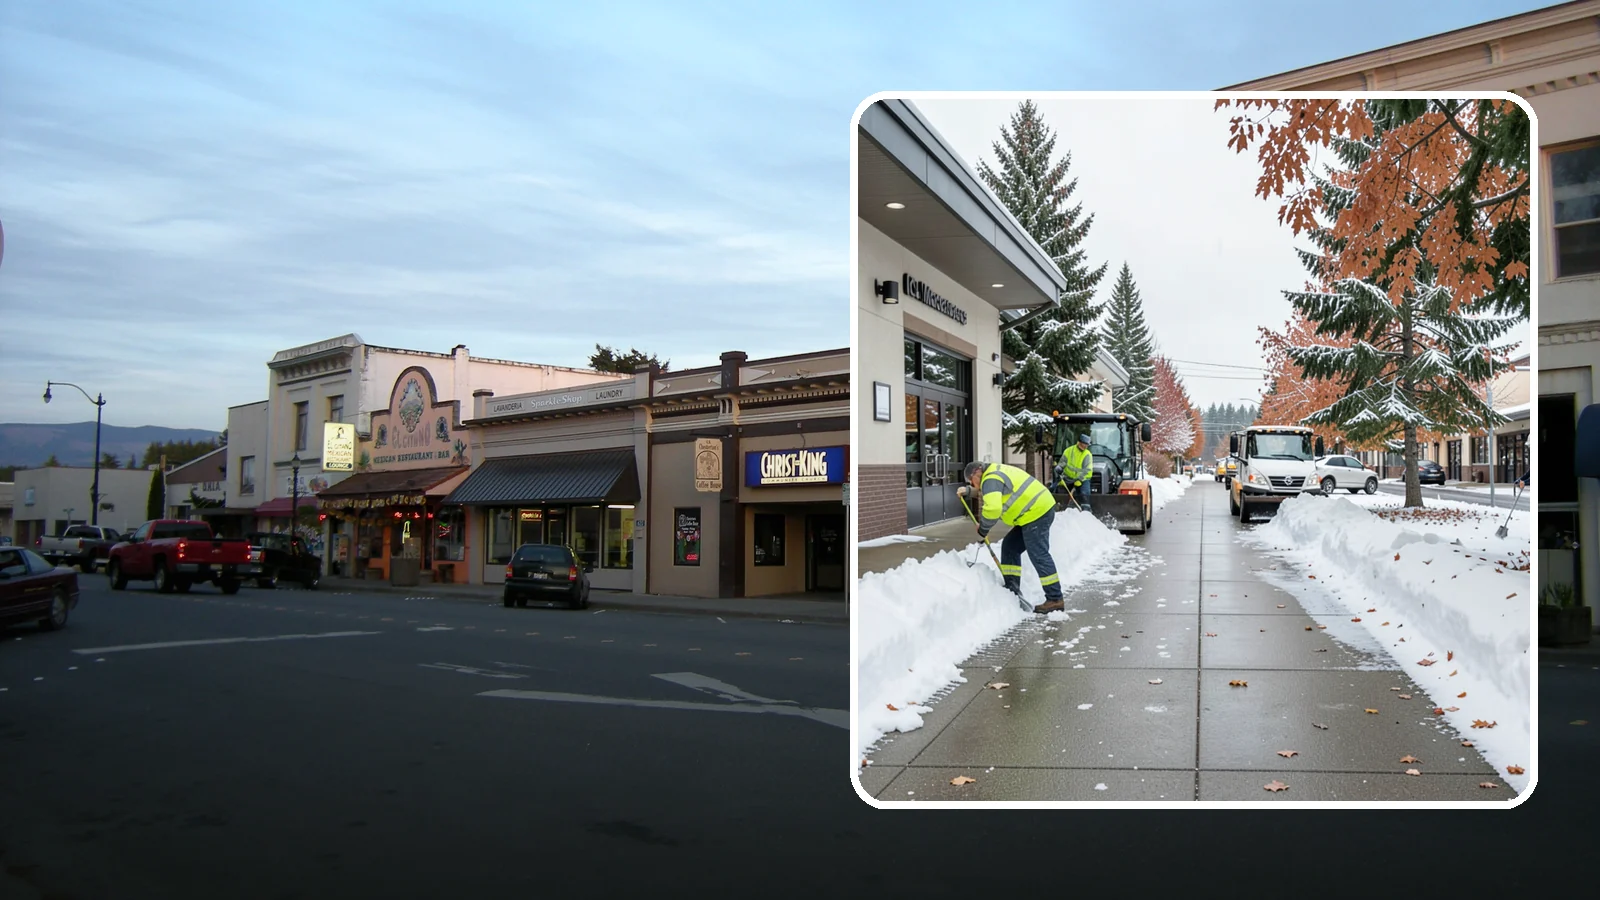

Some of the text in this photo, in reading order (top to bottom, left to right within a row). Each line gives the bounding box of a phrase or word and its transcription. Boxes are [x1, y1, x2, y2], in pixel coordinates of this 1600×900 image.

[562, 394, 582, 405] Shop
[595, 389, 624, 400] LAUNDRY
[493, 402, 523, 413] LAVANDERIA
[397, 451, 433, 462] RESTAURANT
[438, 450, 450, 459] BAR
[761, 450, 827, 478] CHRIST KING
[696, 480, 722, 489] Coffee House
